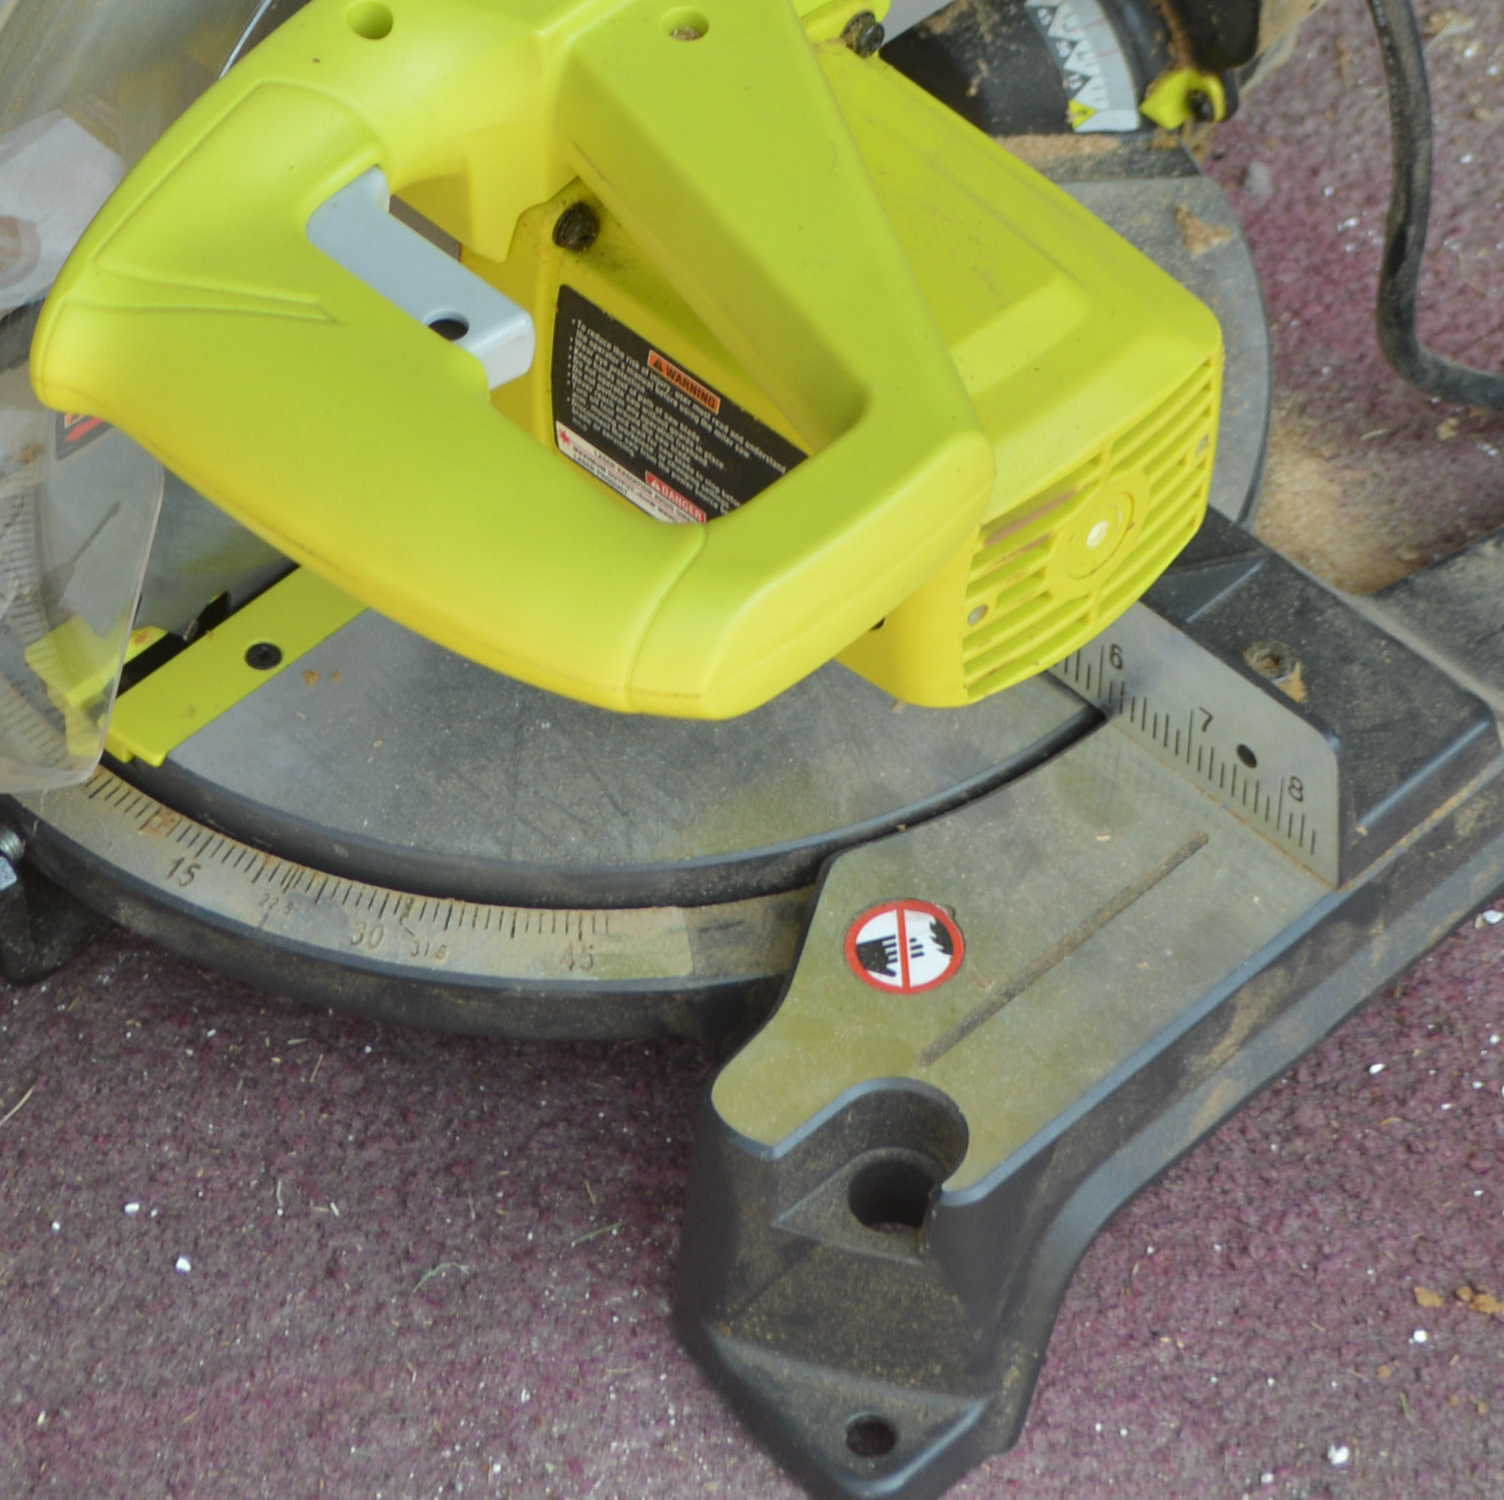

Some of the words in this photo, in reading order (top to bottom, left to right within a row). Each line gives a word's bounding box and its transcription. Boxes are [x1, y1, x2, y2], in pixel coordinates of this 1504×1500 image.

[575, 338, 594, 356] Wear
[574, 346, 592, 367] Keep
[594, 360, 614, 381] hands
[638, 393, 654, 409] path
[666, 366, 717, 411] WARNING
[586, 327, 612, 350] reduce
[675, 390, 691, 407] user
[692, 403, 711, 421] must
[712, 417, 729, 433] read
[745, 440, 786, 474] understand
[597, 383, 624, 407] perform
[641, 414, 674, 442] operation
[598, 374, 625, 398] operate
[642, 406, 669, 429] without
[669, 425, 694, 447] guards
[627, 366, 654, 390] manual
[655, 385, 678, 407] before
[679, 404, 700, 424] using
[714, 428, 733, 446] miter
[640, 447, 657, 464] from
[671, 471, 693, 489] power
[661, 484, 703, 522] DANGER
[1109, 643, 1123, 670] 6
[1198, 706, 1213, 733] 7
[1288, 775, 1304, 802] 8
[166, 856, 201, 888] 15
[350, 920, 385, 949] 30
